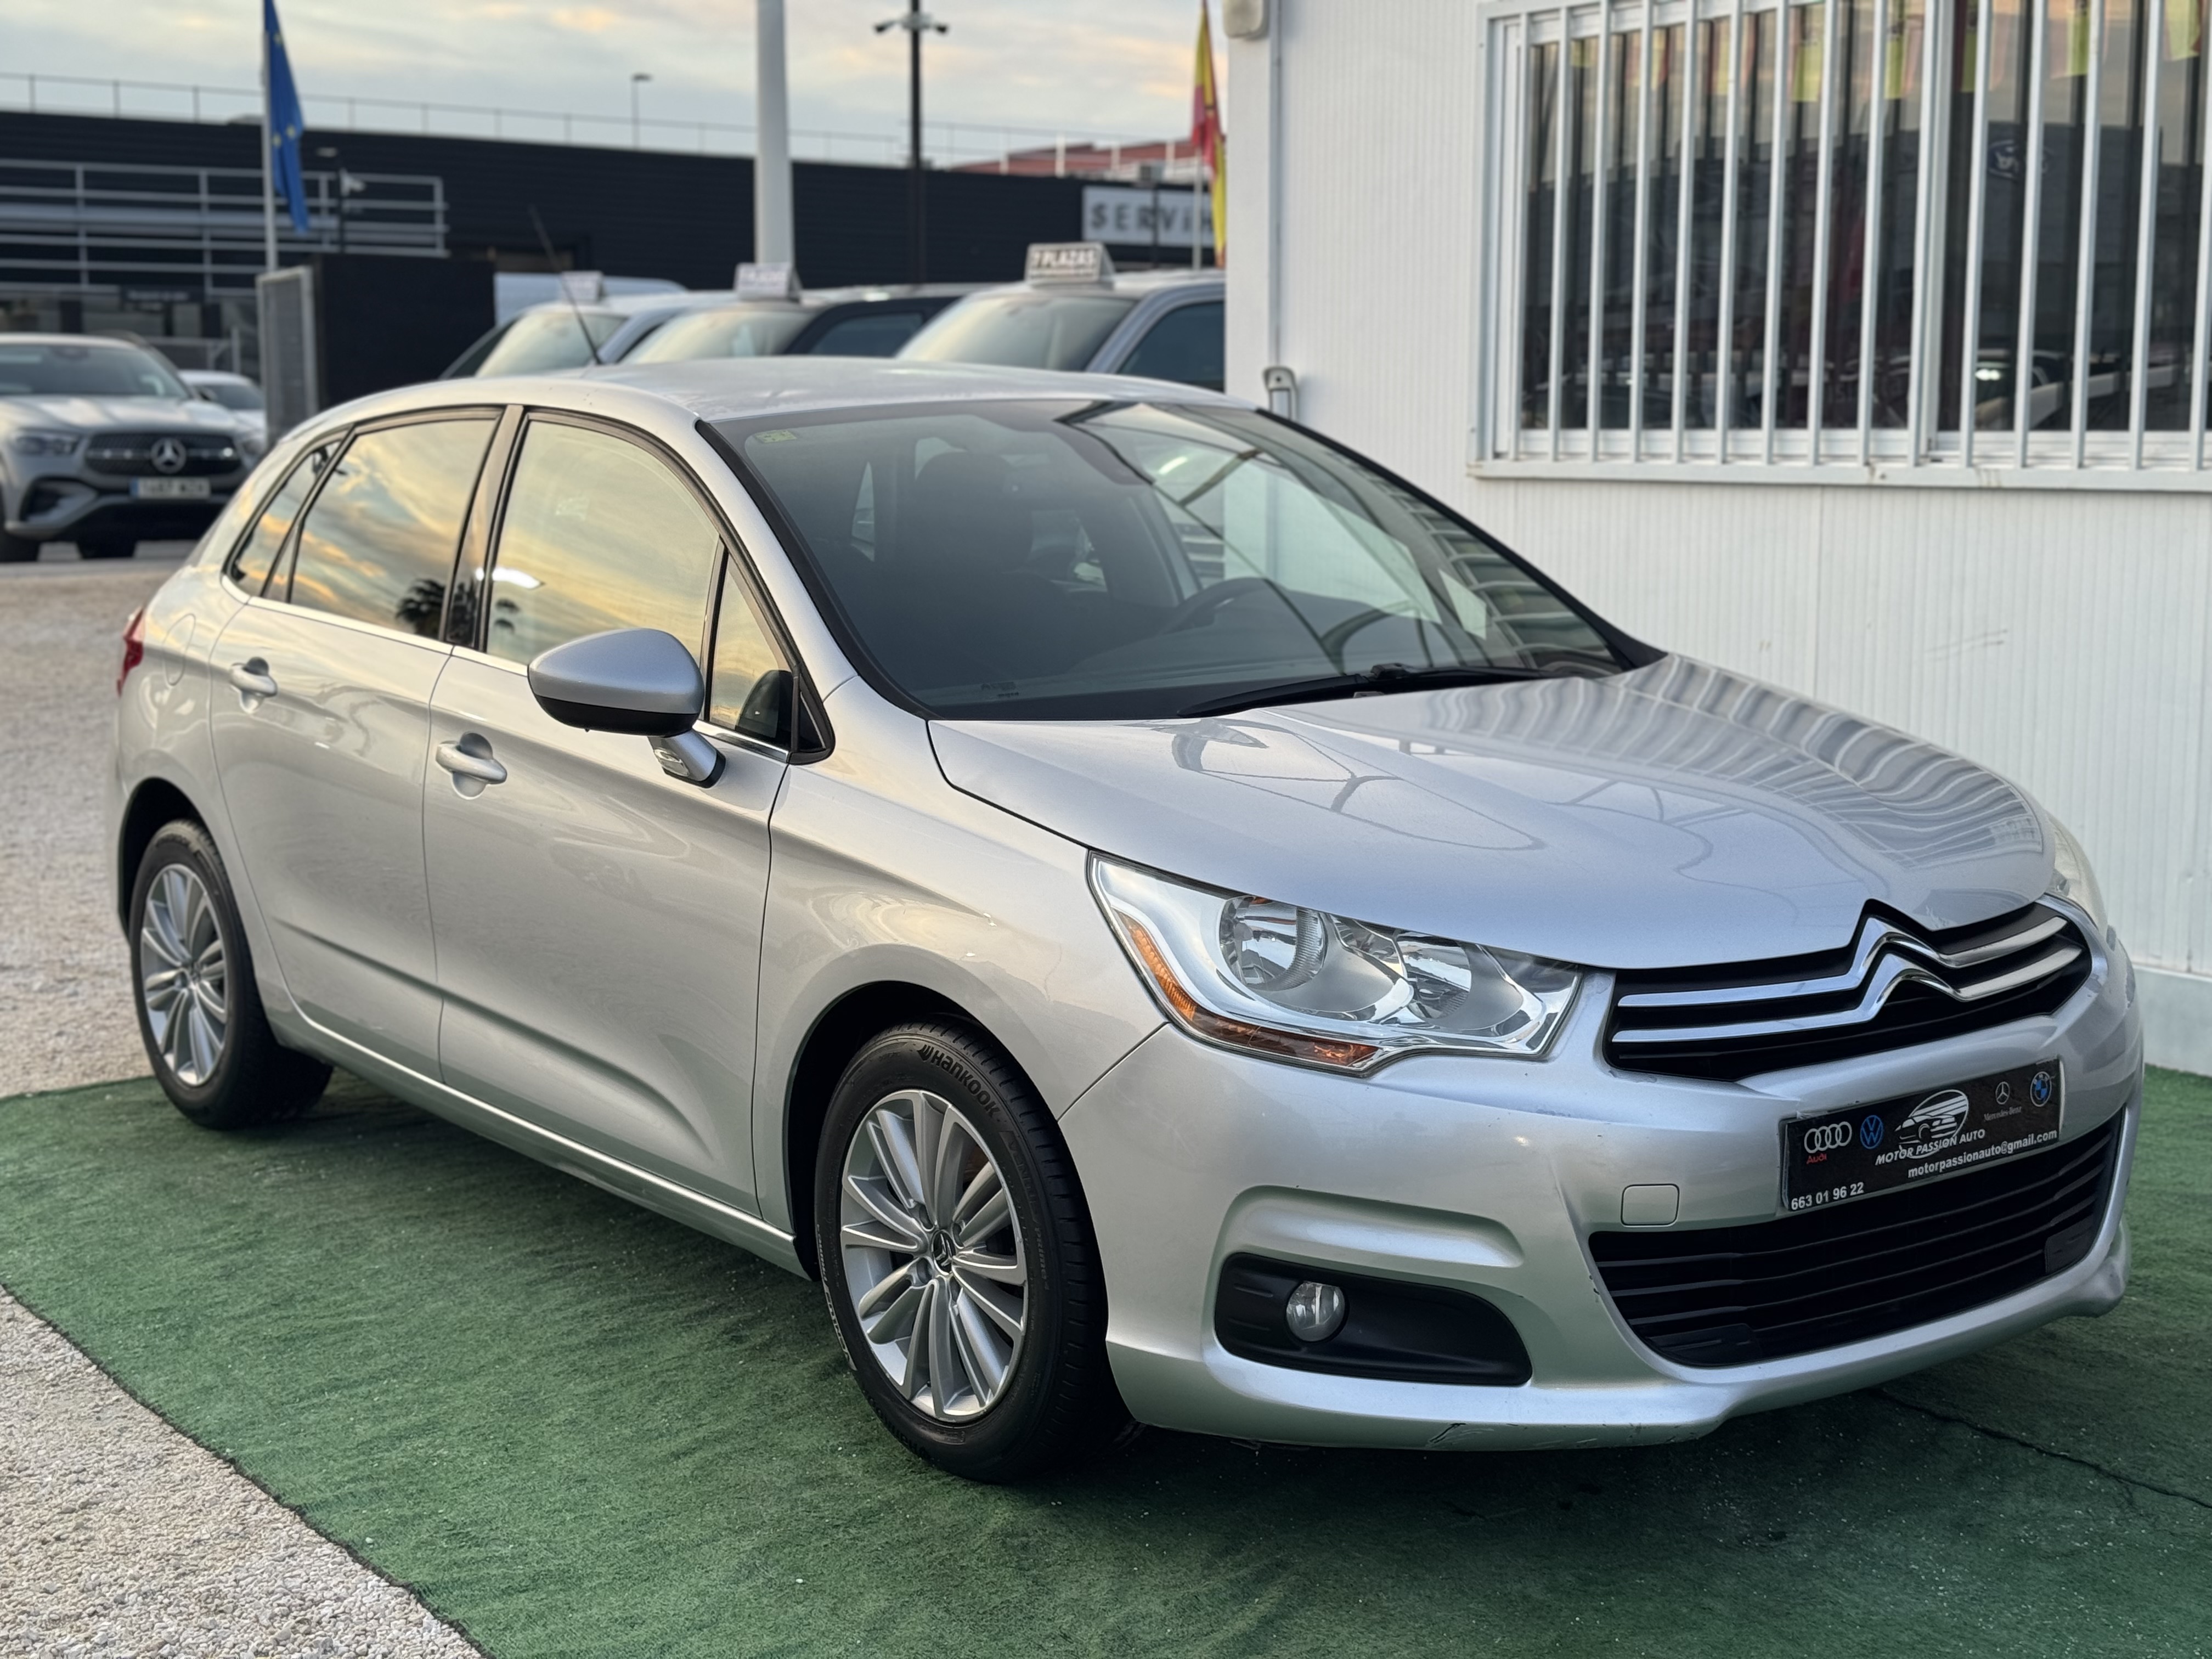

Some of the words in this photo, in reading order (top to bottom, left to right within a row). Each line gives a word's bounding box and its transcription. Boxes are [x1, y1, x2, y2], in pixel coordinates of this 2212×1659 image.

[1807, 1153, 1827, 1164] Audi
[1875, 1148, 1914, 1165] MOTOR
[1916, 1136, 1957, 1155] PASSION
[1959, 1128, 1985, 1144] AUTO
[1908, 1130, 2057, 1178] motorpassionauto@gmail.com
[1791, 1194, 1813, 1210] 663
[1815, 1190, 1829, 1204] 01
[1833, 1186, 1847, 1200] 96
[1850, 1182, 1864, 1196] 22
